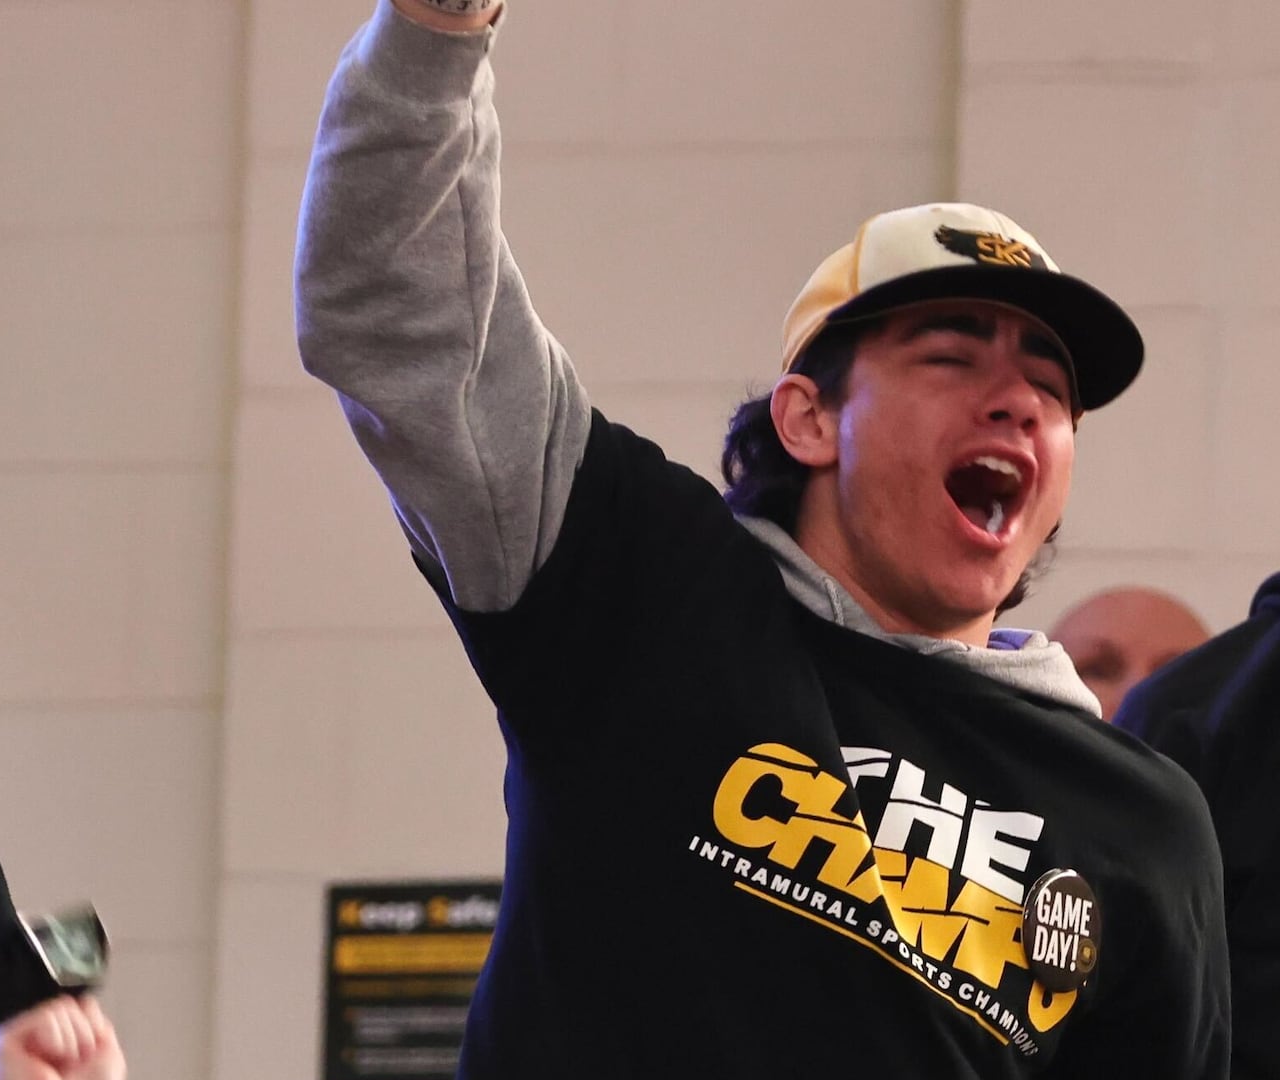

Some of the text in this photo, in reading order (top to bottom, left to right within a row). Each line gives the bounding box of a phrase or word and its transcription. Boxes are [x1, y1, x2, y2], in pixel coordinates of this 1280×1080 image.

[839, 746, 1045, 904] THE
[688, 836, 1039, 1056] INTRAMURAL SPORTS CHAMPIONS
[1032, 925, 1079, 972] DAY!
[1037, 889, 1093, 937] GAME
